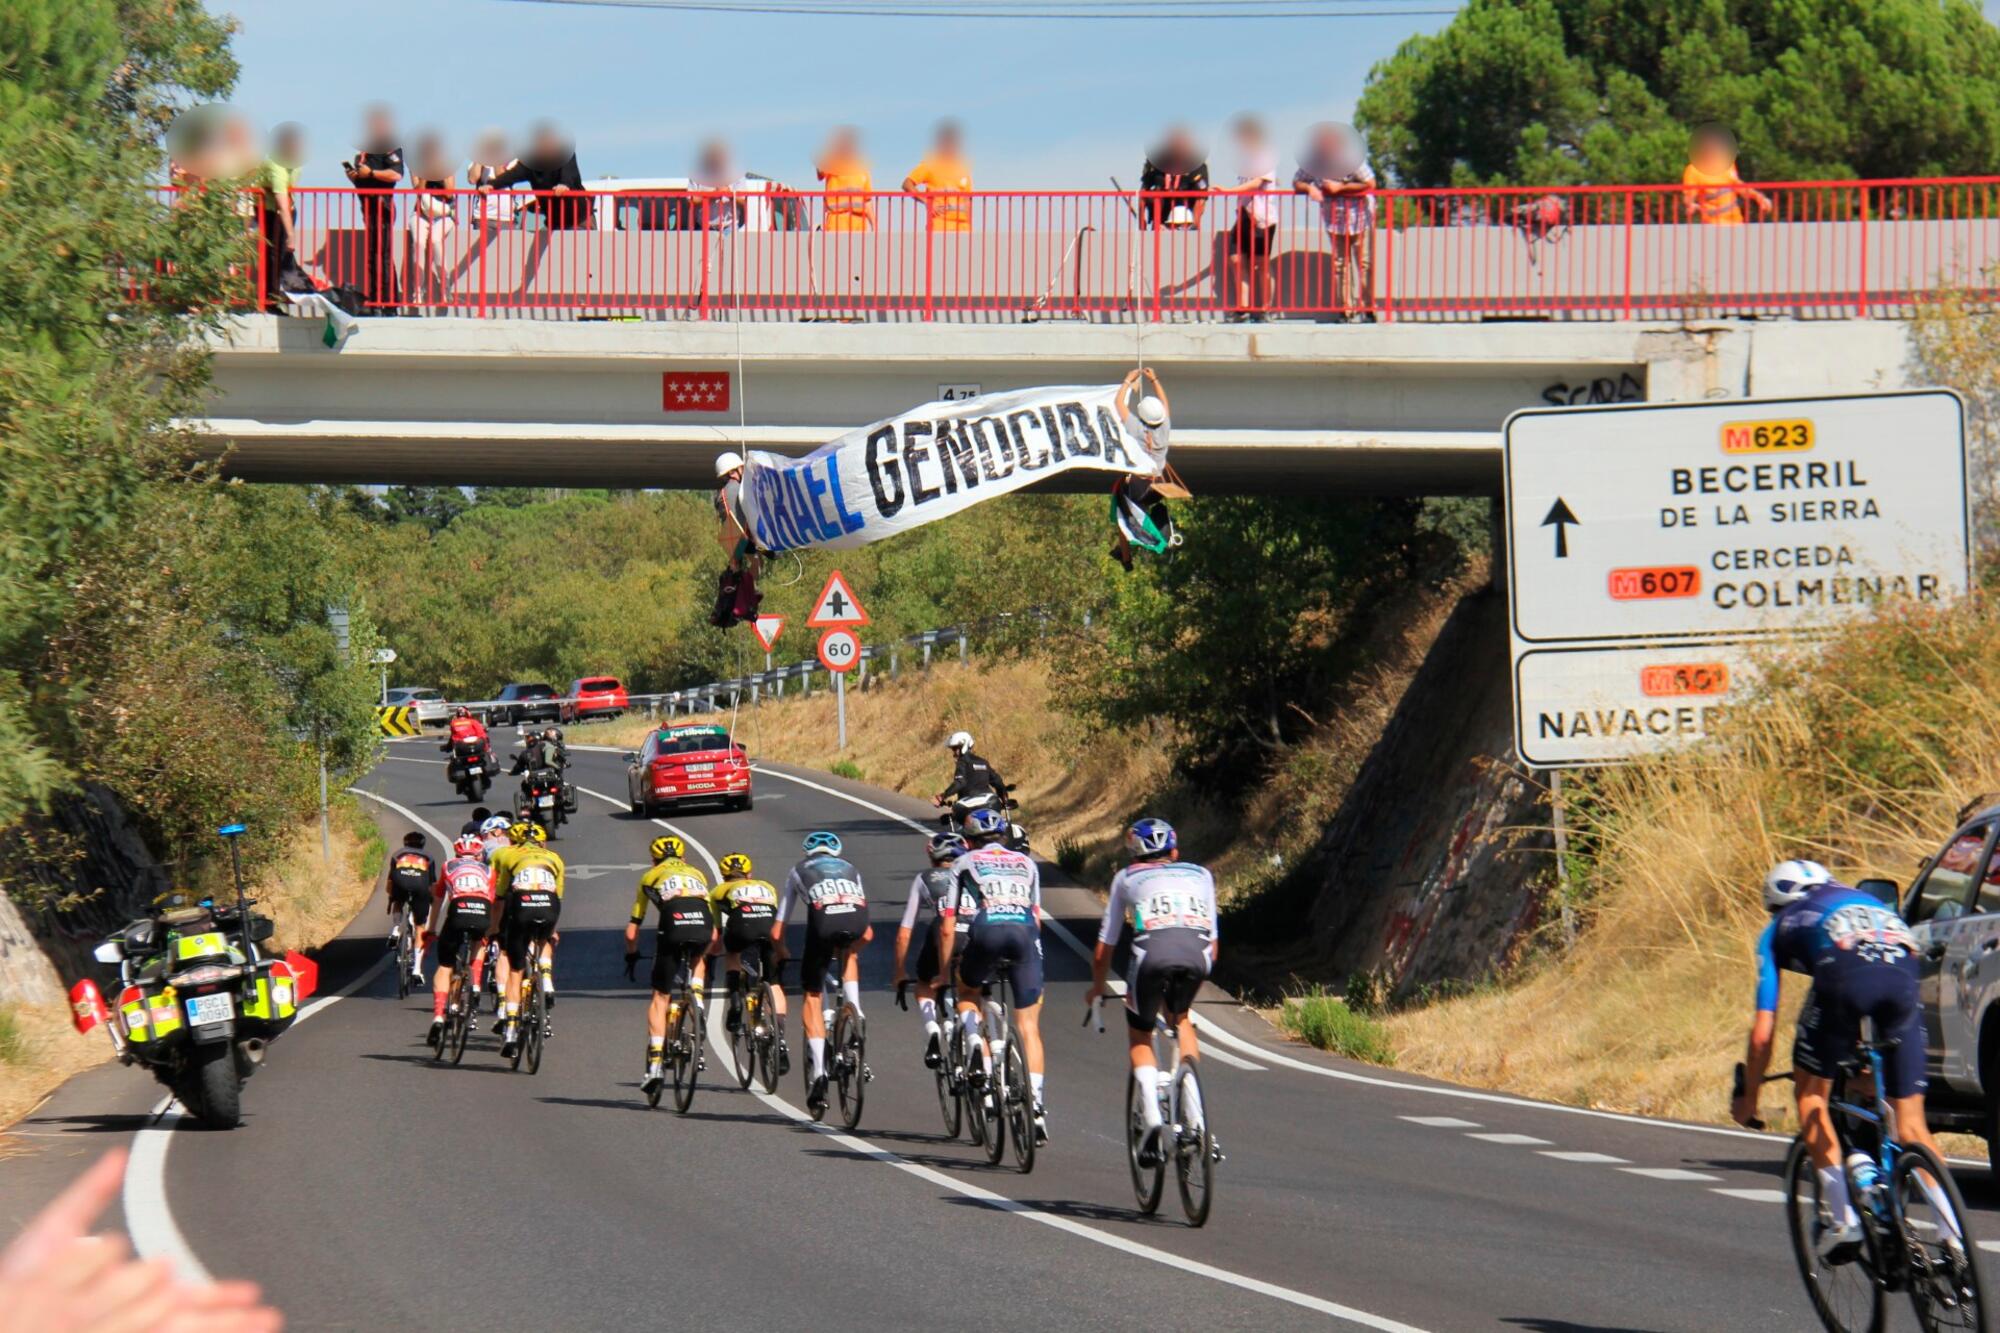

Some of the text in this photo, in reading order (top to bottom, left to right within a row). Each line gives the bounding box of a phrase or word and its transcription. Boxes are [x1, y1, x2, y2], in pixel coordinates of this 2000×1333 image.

[1725, 424, 1809, 449] M623
[865, 402, 1137, 518] GENOCIDA
[1671, 460, 1867, 495] BECERRIL
[1660, 499, 1881, 528] DE LA SIERRA
[1711, 545, 1854, 571] CERCEDA
[1612, 570, 1696, 597] M607
[828, 642, 851, 657] 60
[1539, 705, 1725, 739] NAVACER
[1151, 895, 1171, 915] 45
